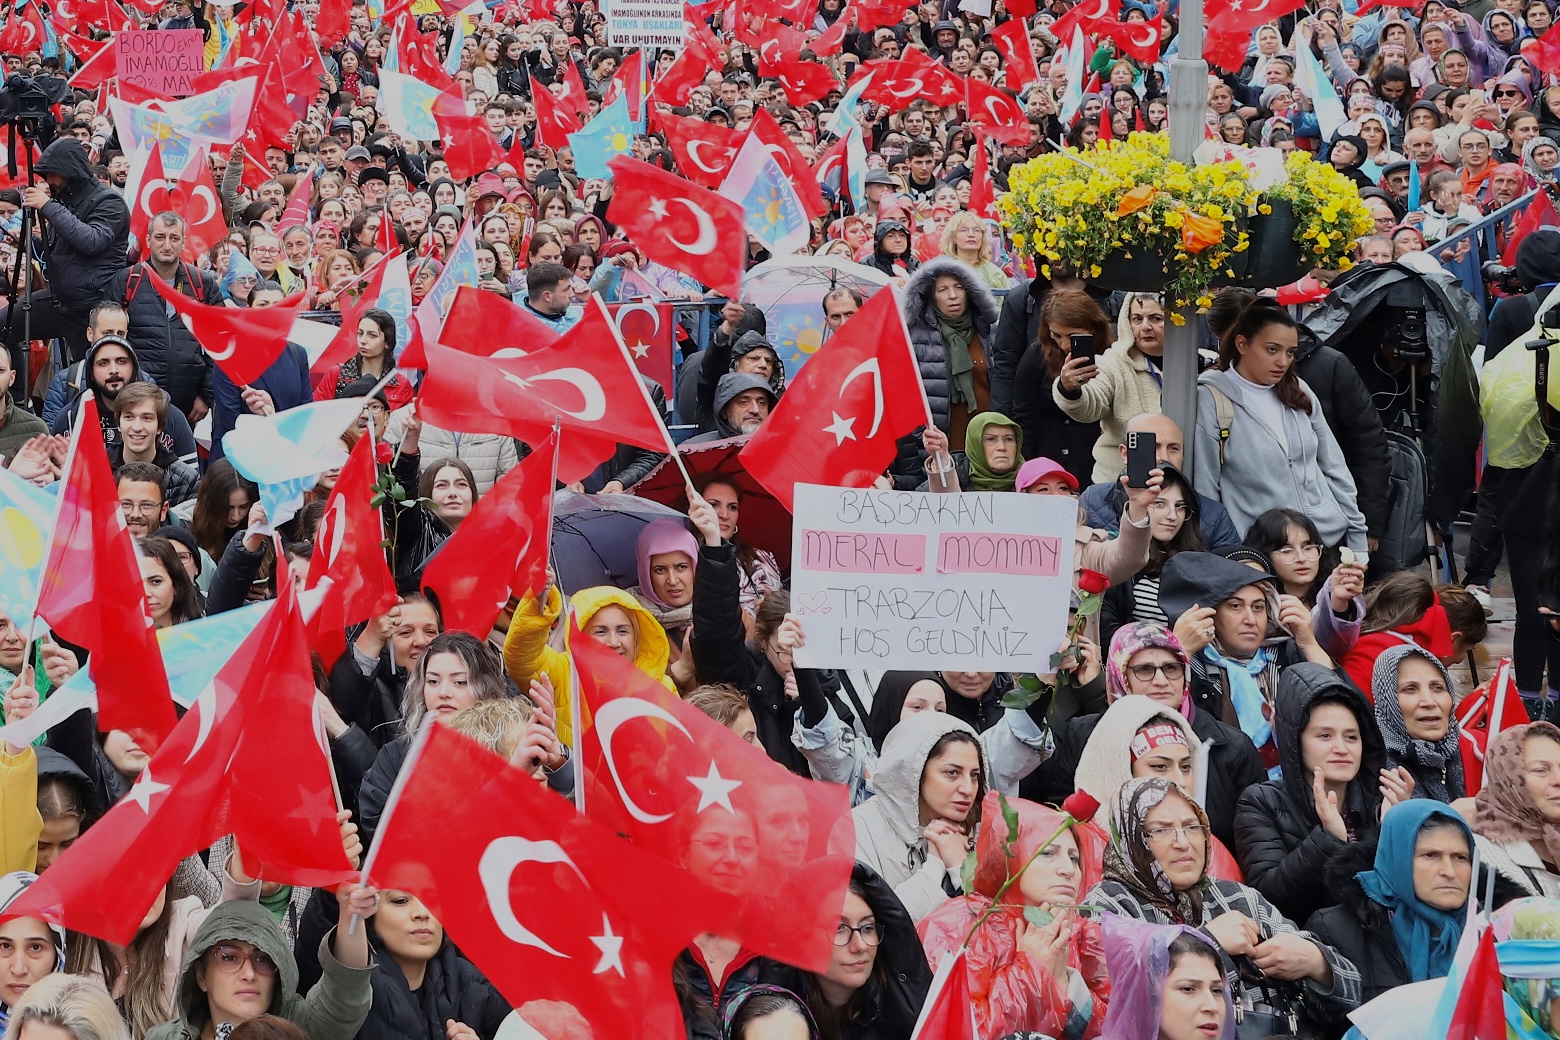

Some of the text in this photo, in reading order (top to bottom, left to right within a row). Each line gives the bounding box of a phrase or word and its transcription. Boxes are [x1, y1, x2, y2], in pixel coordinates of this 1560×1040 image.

[612, 20, 682, 31] TONYA UŞAKLARI
[120, 33, 176, 54] BORDO
[613, 35, 630, 44] VAR
[836, 489, 994, 527] BAŞBAKAN
[805, 530, 1058, 572] MERAL MOMMY
[827, 584, 1014, 625] TRABZONA
[839, 625, 1033, 659] HOŞ GELDİNİZ
[1137, 745, 1148, 756] CHP
